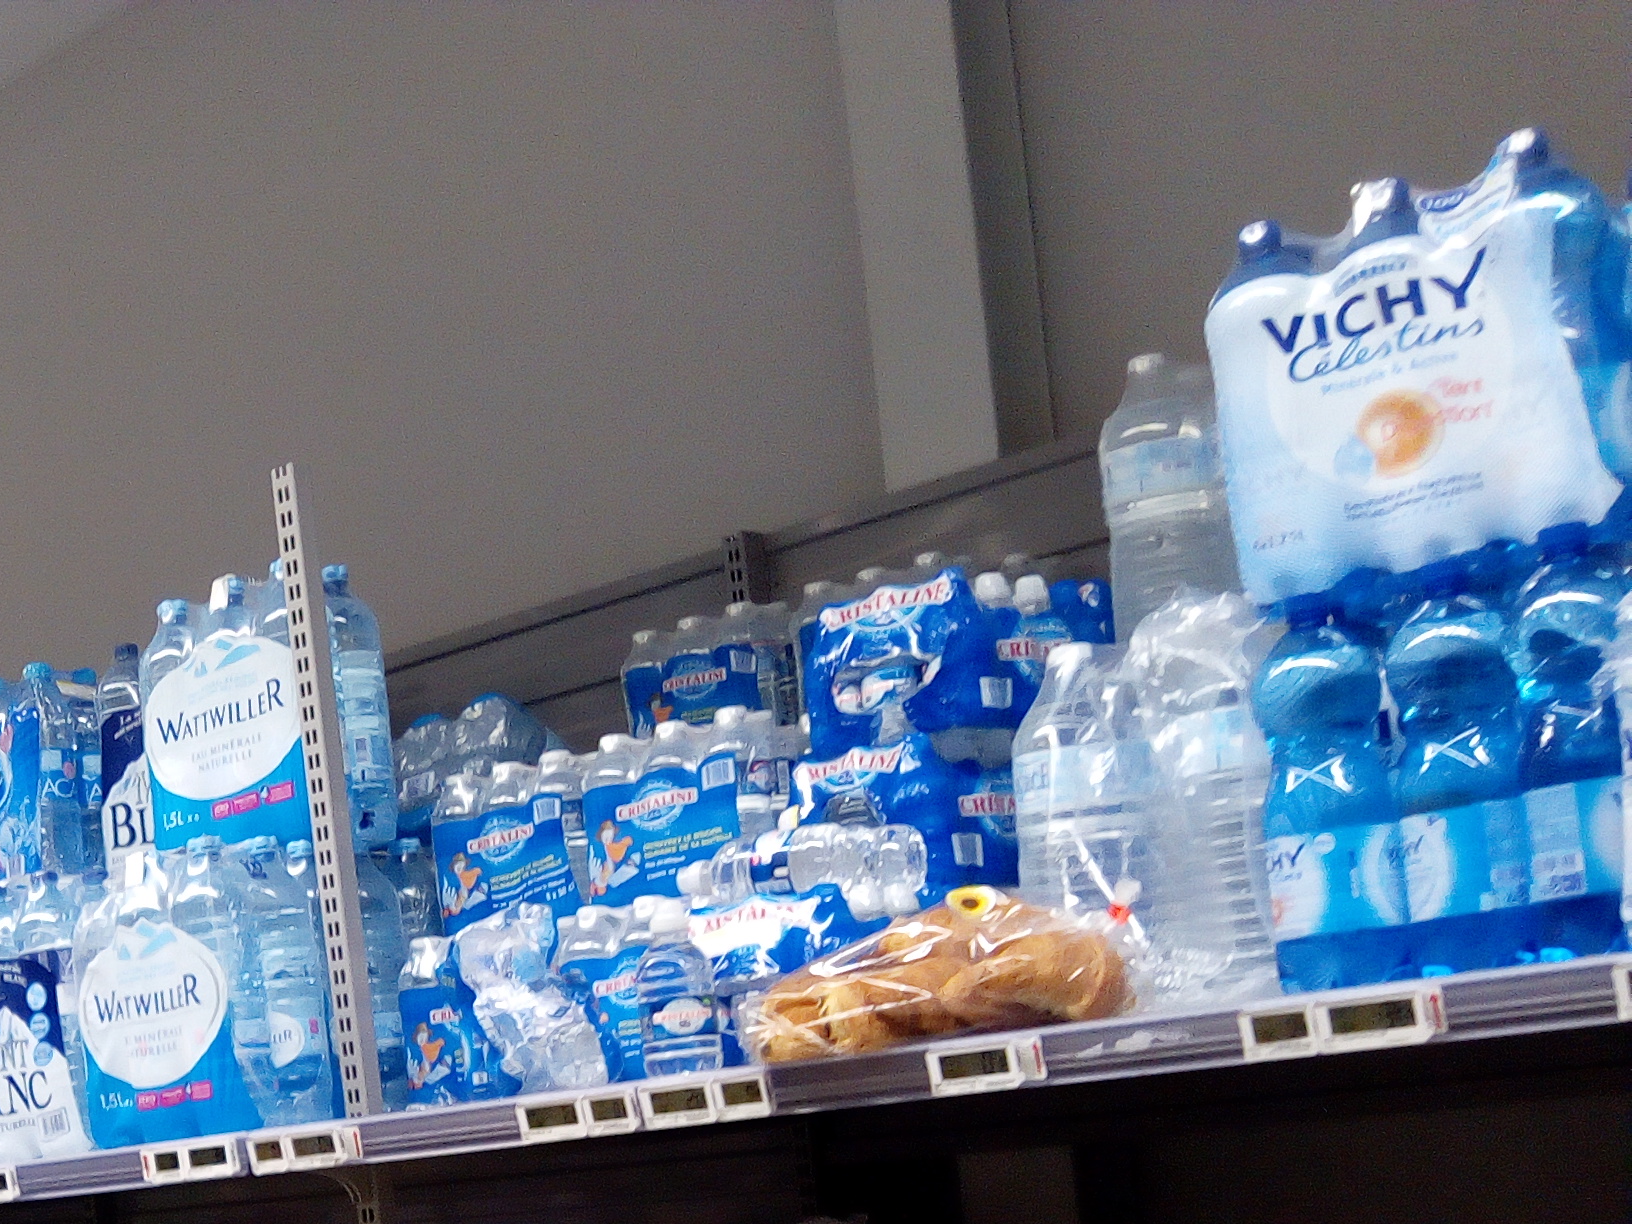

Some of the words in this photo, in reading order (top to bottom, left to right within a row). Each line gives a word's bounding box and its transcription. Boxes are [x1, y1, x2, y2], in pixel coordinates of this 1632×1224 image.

[1261, 246, 1488, 355] VICHY
[1288, 315, 1487, 384] Célestins
[824, 578, 949, 629] CRISTALINE
[156, 677, 285, 745] WATTWILLER
[795, 749, 900, 780] RISTALINE
[618, 789, 695, 819] CRISTALINE
